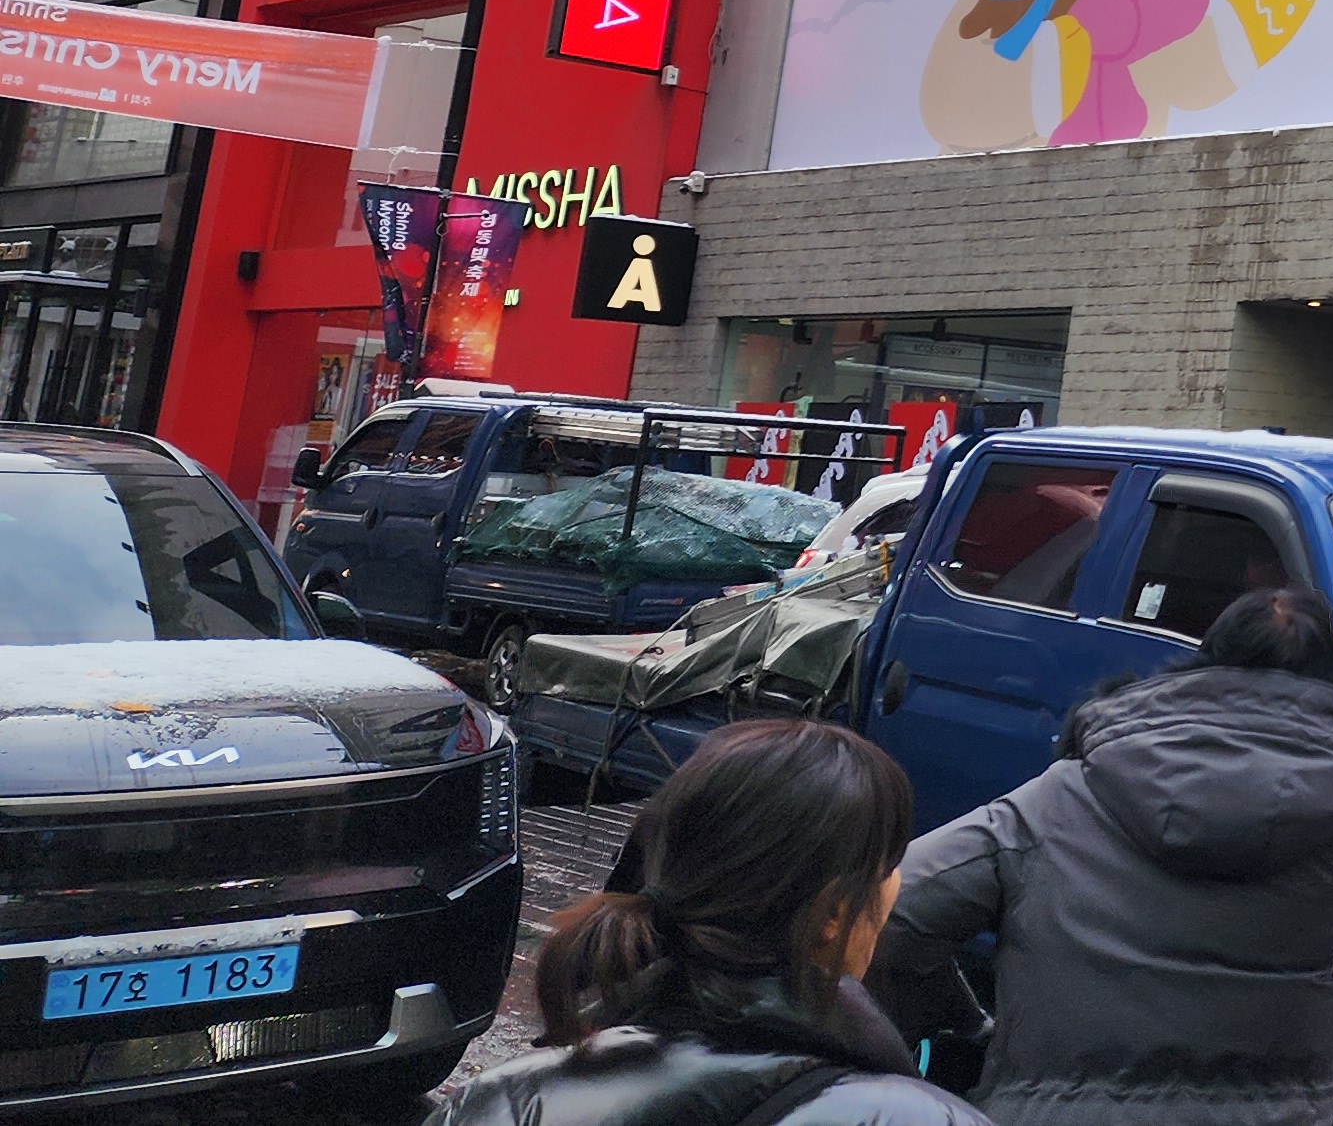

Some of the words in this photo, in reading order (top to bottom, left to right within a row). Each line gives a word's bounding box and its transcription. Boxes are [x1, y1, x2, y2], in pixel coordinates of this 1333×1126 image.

[391, 200, 410, 251] Shining
[126, 744, 241, 772] KIA
[72, 968, 150, 1011] 17호
[176, 954, 275, 1000] 1183
